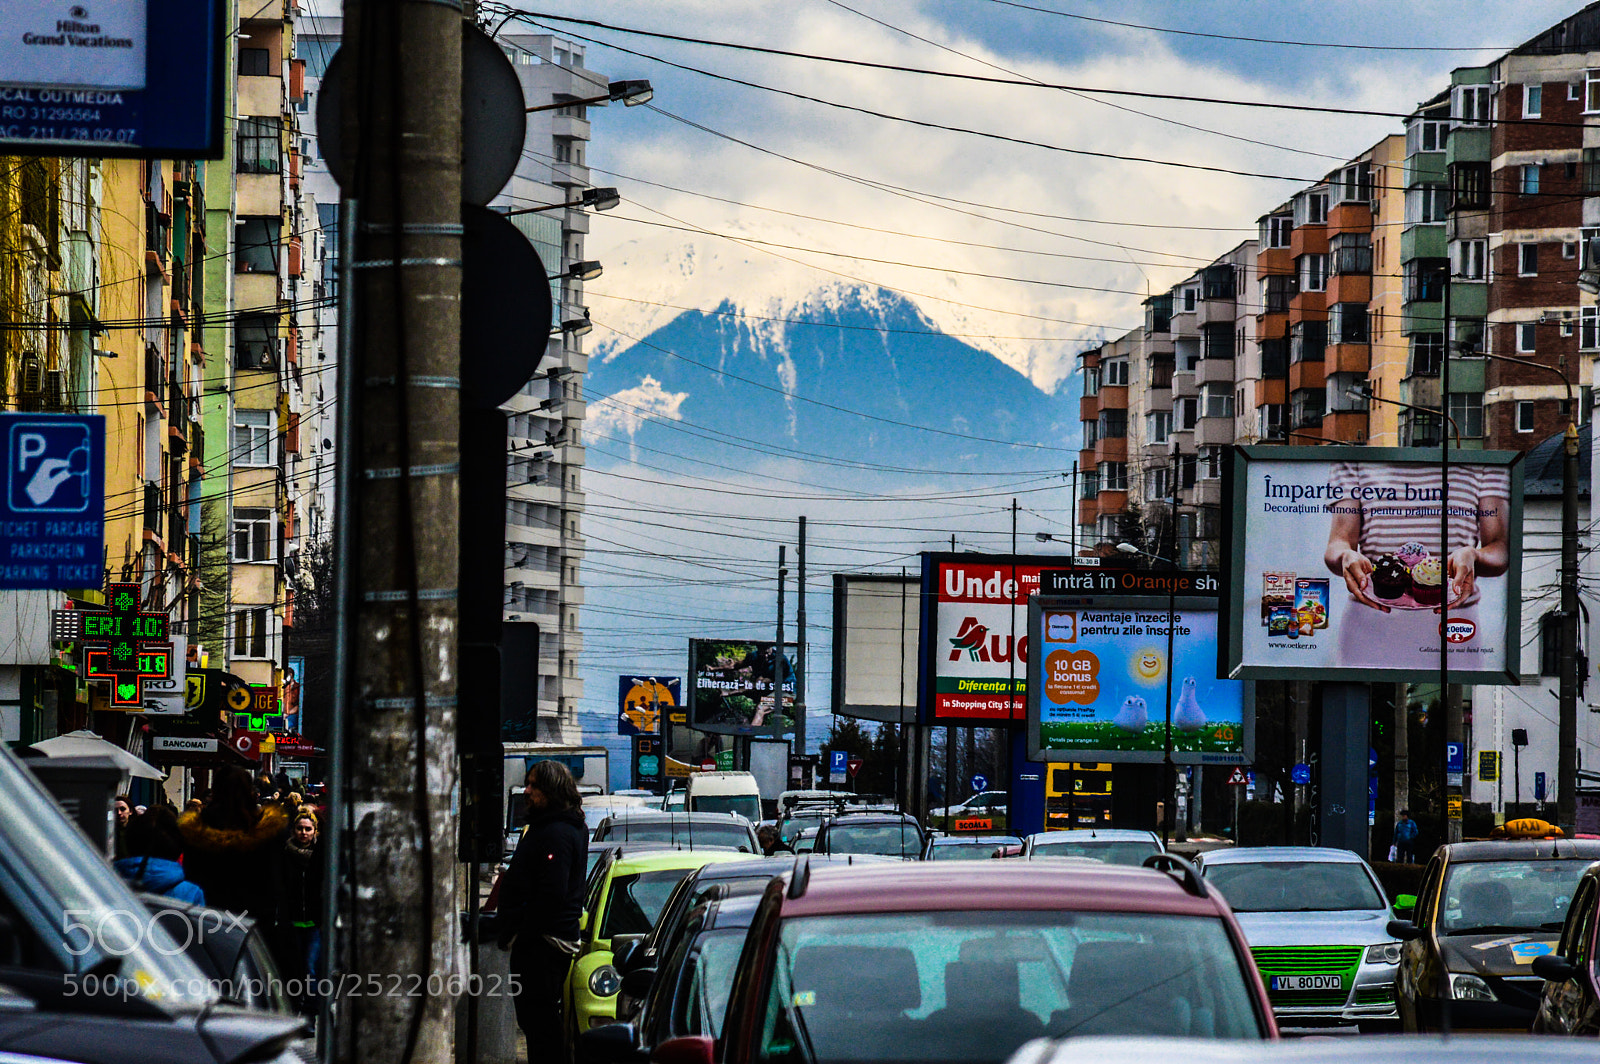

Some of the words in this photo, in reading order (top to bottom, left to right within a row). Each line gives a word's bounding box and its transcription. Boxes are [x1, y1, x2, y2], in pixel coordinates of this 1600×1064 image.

[56, 20, 100, 34] Hilton
[23, 32, 65, 46] Grand
[67, 35, 133, 49] Vacations
[0, 87, 33, 101] CAL
[38, 90, 124, 105] OUTMEDIA
[19, 433, 47, 472] P
[1264, 474, 1344, 503] Împarte
[1350, 485, 1398, 501] ceva
[1322, 504, 1368, 515] frumoase
[1370, 508, 1403, 517] pentru
[45, 521, 99, 537] PARCARE
[10, 543, 85, 559] PARKSCHEIN
[57, 564, 98, 580] TICKET
[945, 569, 1019, 600] Unde
[1053, 573, 1094, 589] intră
[1099, 572, 1116, 589] în
[1121, 573, 1190, 593] Orange
[1195, 574, 1220, 591] sh
[1080, 611, 1132, 625] Avantaje
[1080, 625, 1120, 636] pentru
[1122, 625, 1143, 635] zile
[1450, 625, 1473, 633] Oetker
[1268, 642, 1317, 650] www.oetker.ro
[1054, 660, 1068, 671] 10
[1071, 660, 1092, 671] GB
[1053, 670, 1092, 682] bonus
[755, 681, 767, 691] de
[958, 680, 1007, 693] Diferența
[951, 699, 987, 710] Shopping
[988, 700, 1003, 710] City
[1213, 728, 1234, 740] 4G
[162, 740, 208, 749] BANCOMAT
[835, 752, 844, 766] P
[1447, 745, 1458, 763] P
[1513, 820, 1541, 832] TAXI
[1278, 977, 1295, 989] VL
